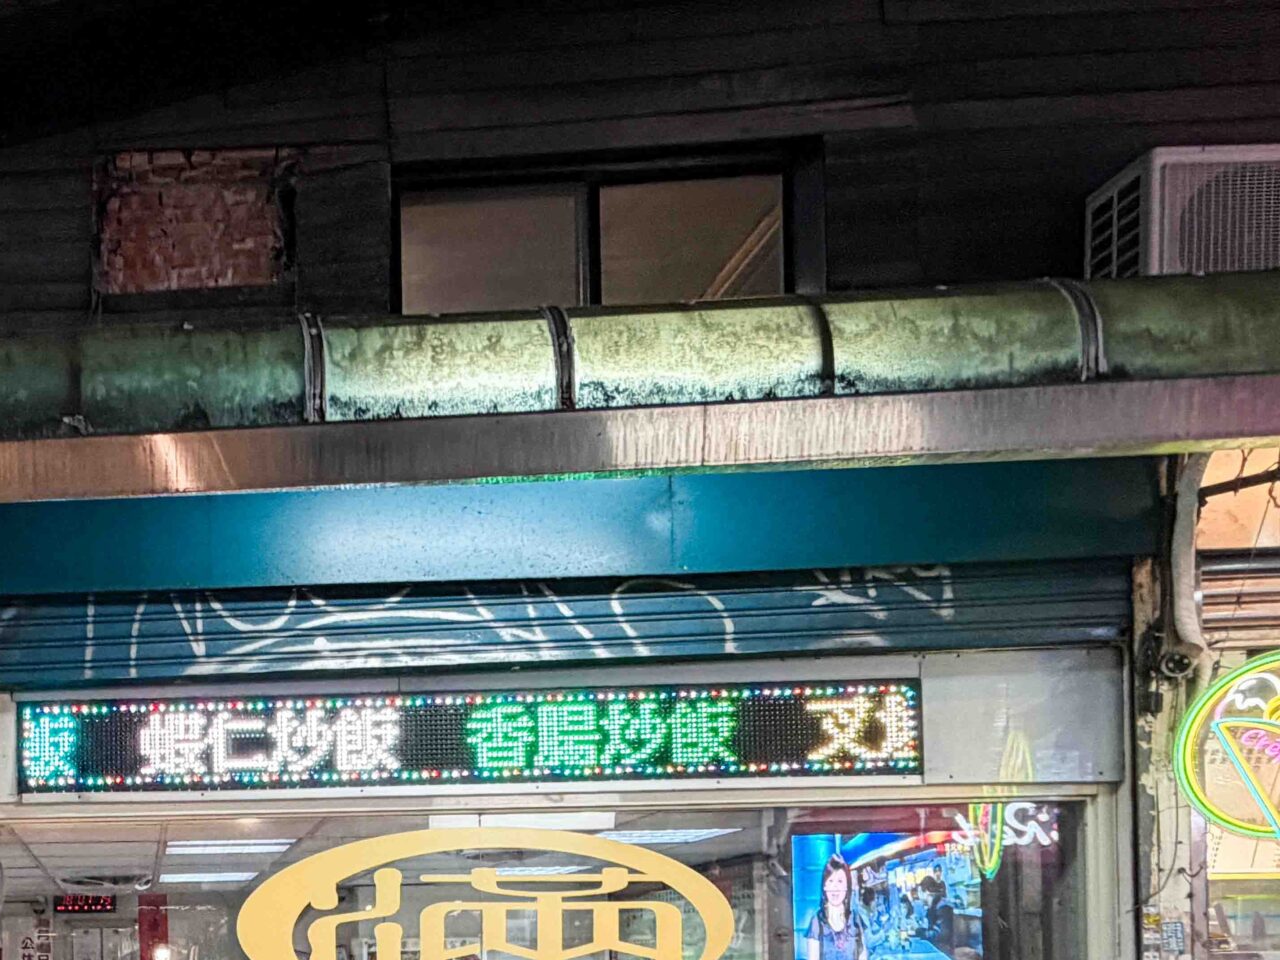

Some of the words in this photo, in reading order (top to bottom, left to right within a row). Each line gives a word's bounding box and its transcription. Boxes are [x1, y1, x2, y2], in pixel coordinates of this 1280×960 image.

[140, 708, 402, 775] 蝦仁炒飯
[466, 700, 738, 767] 香腸炒飯
